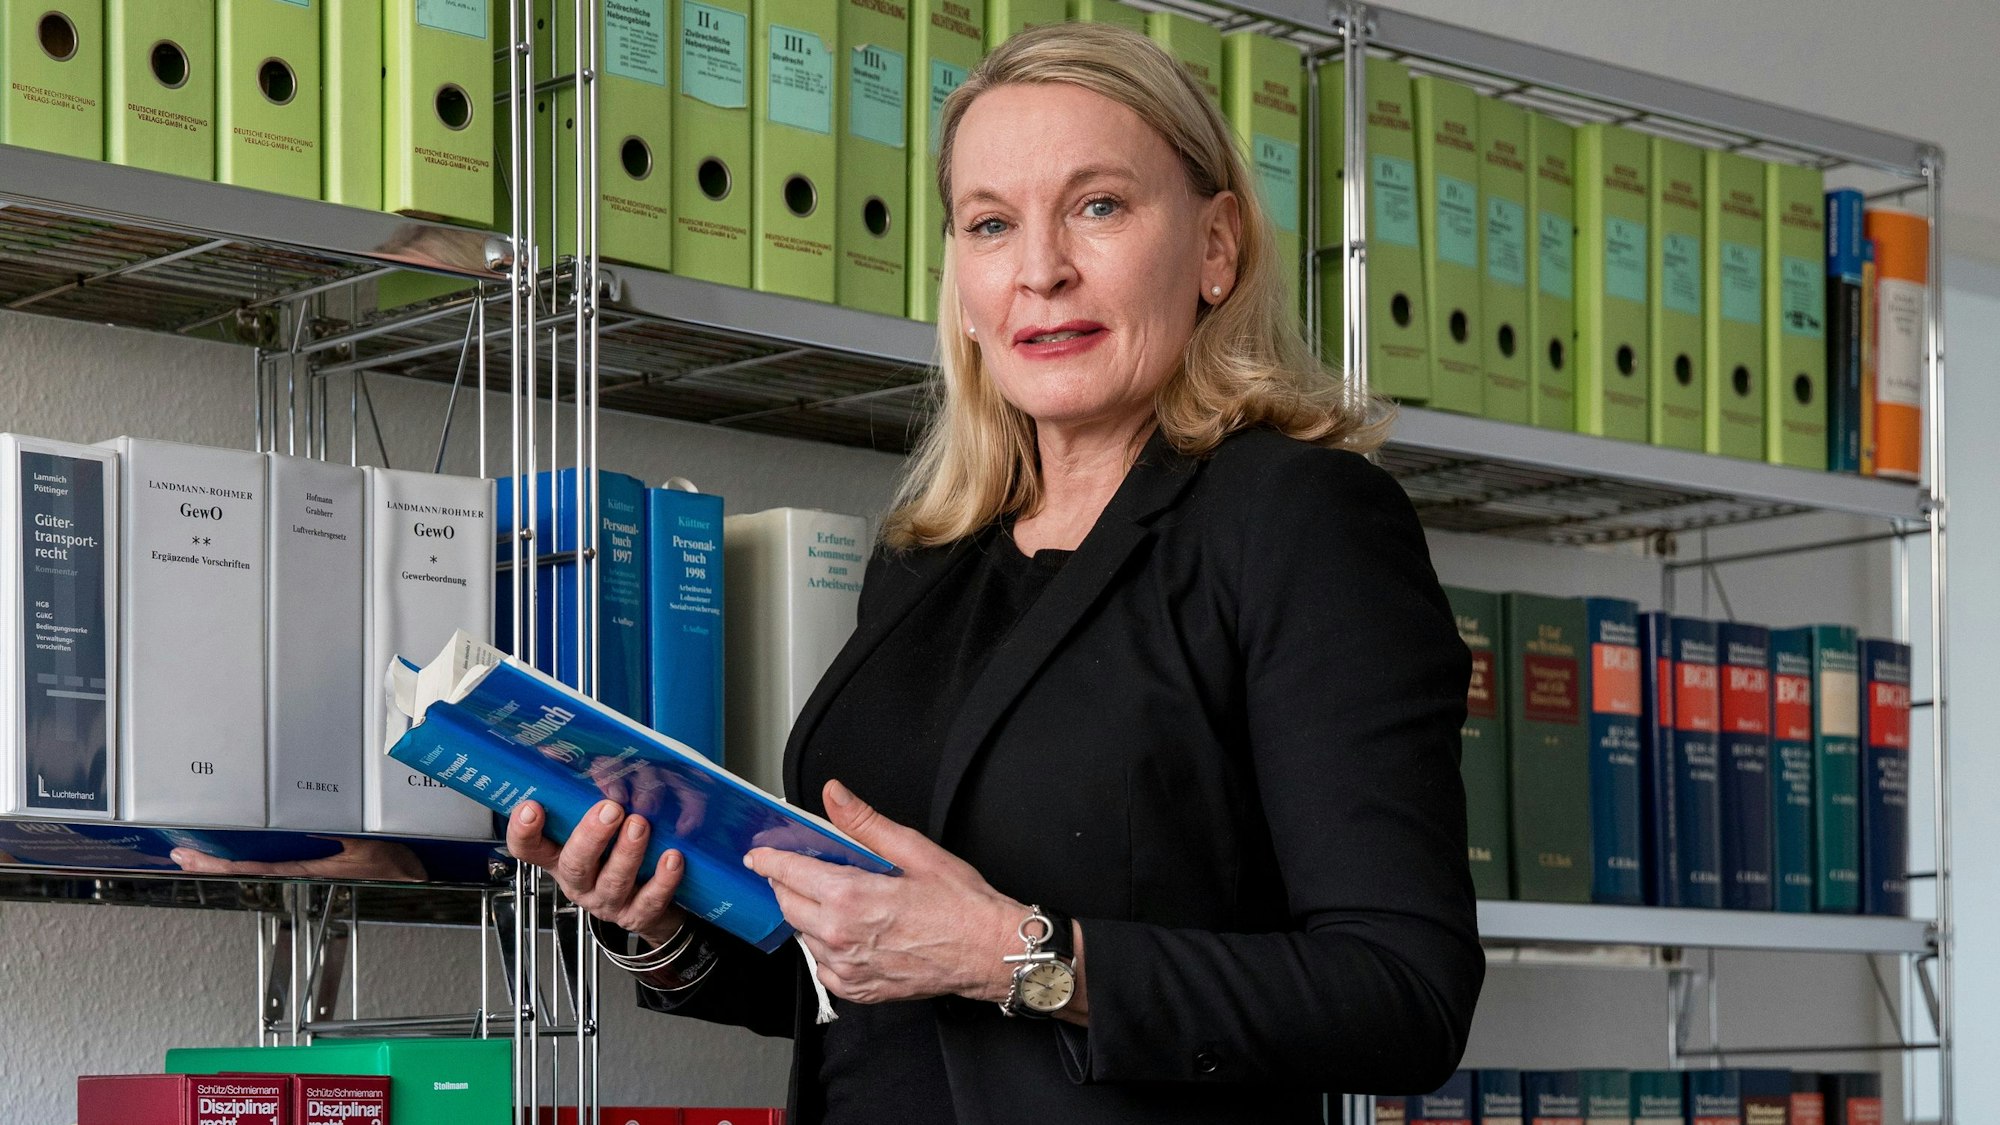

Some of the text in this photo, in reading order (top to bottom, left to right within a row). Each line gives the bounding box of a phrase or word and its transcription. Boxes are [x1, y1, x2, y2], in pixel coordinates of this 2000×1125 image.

[606, 1, 650, 18] Zivilrechtliche
[606, 12, 651, 28] Nebengebiete
[698, 11, 719, 30] II d
[685, 28, 730, 46] Zivilrechtliche
[784, 34, 804, 54] III
[685, 38, 730, 55] Nebengebiete
[772, 52, 804, 66] Strafrecht
[863, 50, 880, 70] III
[12, 82, 96, 107] DEUTSCHE RECHTSPRECHUNG
[23, 93, 70, 110] VERLAGS-GMBH
[128, 102, 208, 127] DEUTSCHE RECHTSPRECHUNG
[138, 112, 183, 130] VERLAGS-GMBH
[233, 127, 314, 148] DEUTSCHE RECHTSPRECHUNG
[244, 137, 289, 151] VERLAGS-GMBH
[295, 146, 302, 154] Co
[414, 147, 489, 168] DEUTSCHE RECHTSPRECHUNG
[424, 156, 466, 171] VERLAGS-GMBH
[602, 193, 667, 214] DEUTSCHE RECHTSPRECHUNG
[678, 217, 747, 236] DEUTSCHE RECHTSPRECHUNG
[33, 472, 67, 484] Lammich
[33, 484, 69, 497] Pöttinger
[148, 480, 253, 501] LANDMANN-ROHMER
[305, 493, 334, 505] Hofmann
[607, 498, 635, 514] Küttner
[180, 502, 222, 522] GewO
[305, 506, 334, 519] Grabherr
[386, 500, 484, 519] LANDMANN/ROHMER
[34, 514, 74, 529] Güter-
[602, 517, 639, 536] Personal-
[678, 516, 711, 530] Küttner
[34, 530, 98, 549] transport-
[292, 524, 347, 542] Luftverkehrsgesetz
[414, 522, 454, 541] GewO
[816, 532, 856, 547] Erfurter
[612, 533, 632, 549] buch
[672, 535, 716, 552] Personal-
[35, 546, 68, 561] recht
[151, 550, 250, 570] Ergänzende Vorschriften
[612, 548, 632, 565] 1997
[682, 550, 707, 565] buch
[808, 546, 863, 562] Kommentar
[35, 564, 78, 577] Kommentar
[684, 566, 706, 580] 1998
[828, 565, 848, 576] zum
[401, 571, 467, 587] Gewerbeordnung
[678, 584, 712, 594] Arbeitsrecht
[35, 600, 50, 609] HGB
[680, 593, 711, 604] Lohnsteuer
[35, 611, 53, 620] GüKG
[669, 602, 720, 616] Sozialversicherung
[36, 622, 88, 635] Bedingungswerke
[36, 634, 75, 644] Verwaltungs-
[36, 642, 72, 653] vorschriften
[420, 744, 445, 766] Küttner
[544, 740, 586, 764] 1999
[437, 753, 469, 781] Personal-
[456, 766, 478, 784] buch
[296, 780, 340, 794] C.H.BECK
[473, 774, 492, 792] 1999
[51, 789, 94, 802] Luchterhand
[197, 1084, 279, 1098] Schütz/Schmiemann
[306, 1087, 383, 1102] Schütz/Schmiemann
